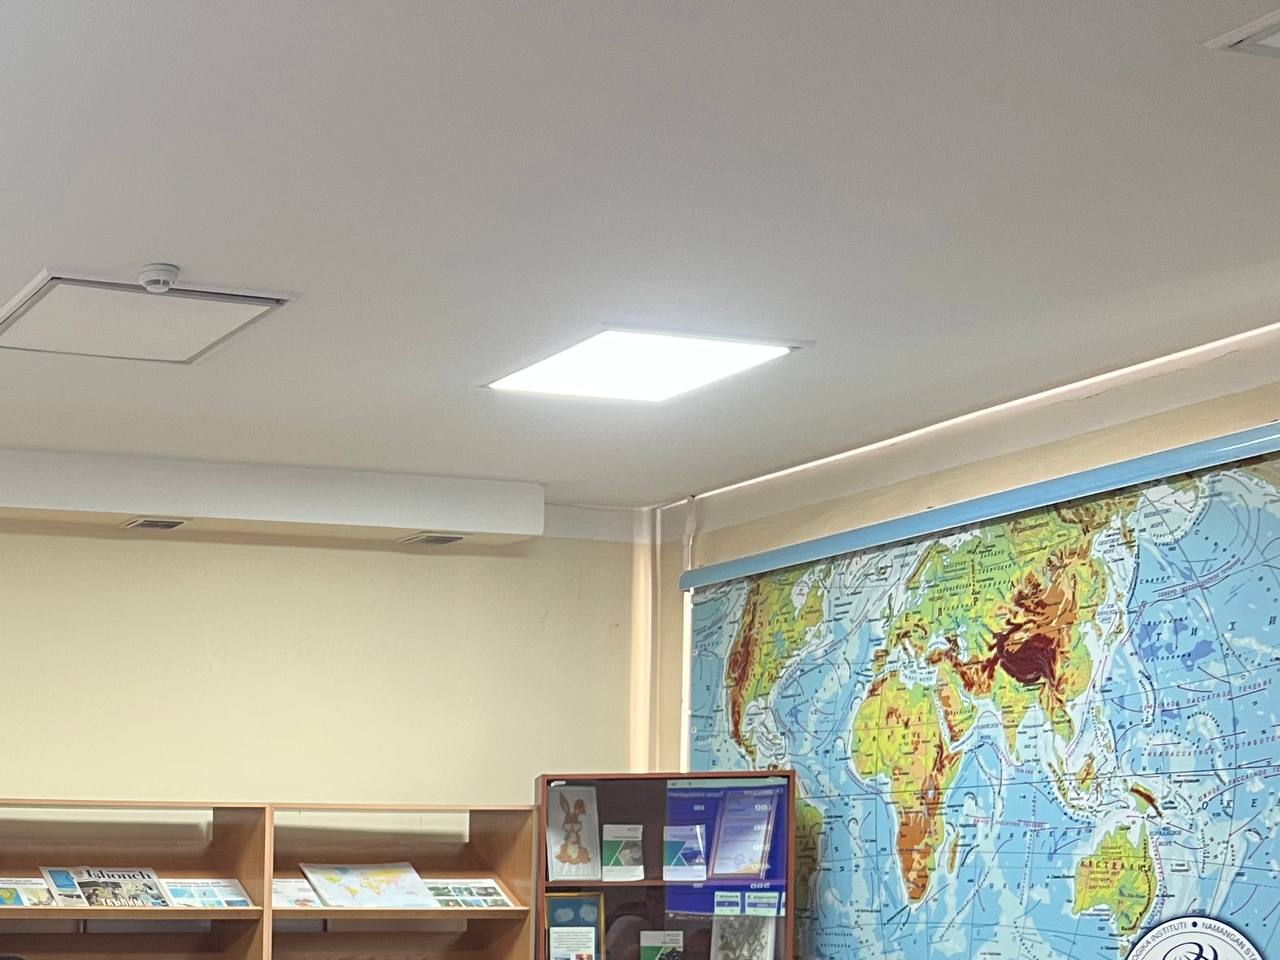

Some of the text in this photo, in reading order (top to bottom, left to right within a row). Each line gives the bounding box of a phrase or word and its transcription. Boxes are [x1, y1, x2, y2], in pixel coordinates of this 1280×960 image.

[85, 869, 153, 881] Ishonch
[1150, 921, 1188, 942] INSTITUTI
[1201, 921, 1246, 951] NAMANGAN
